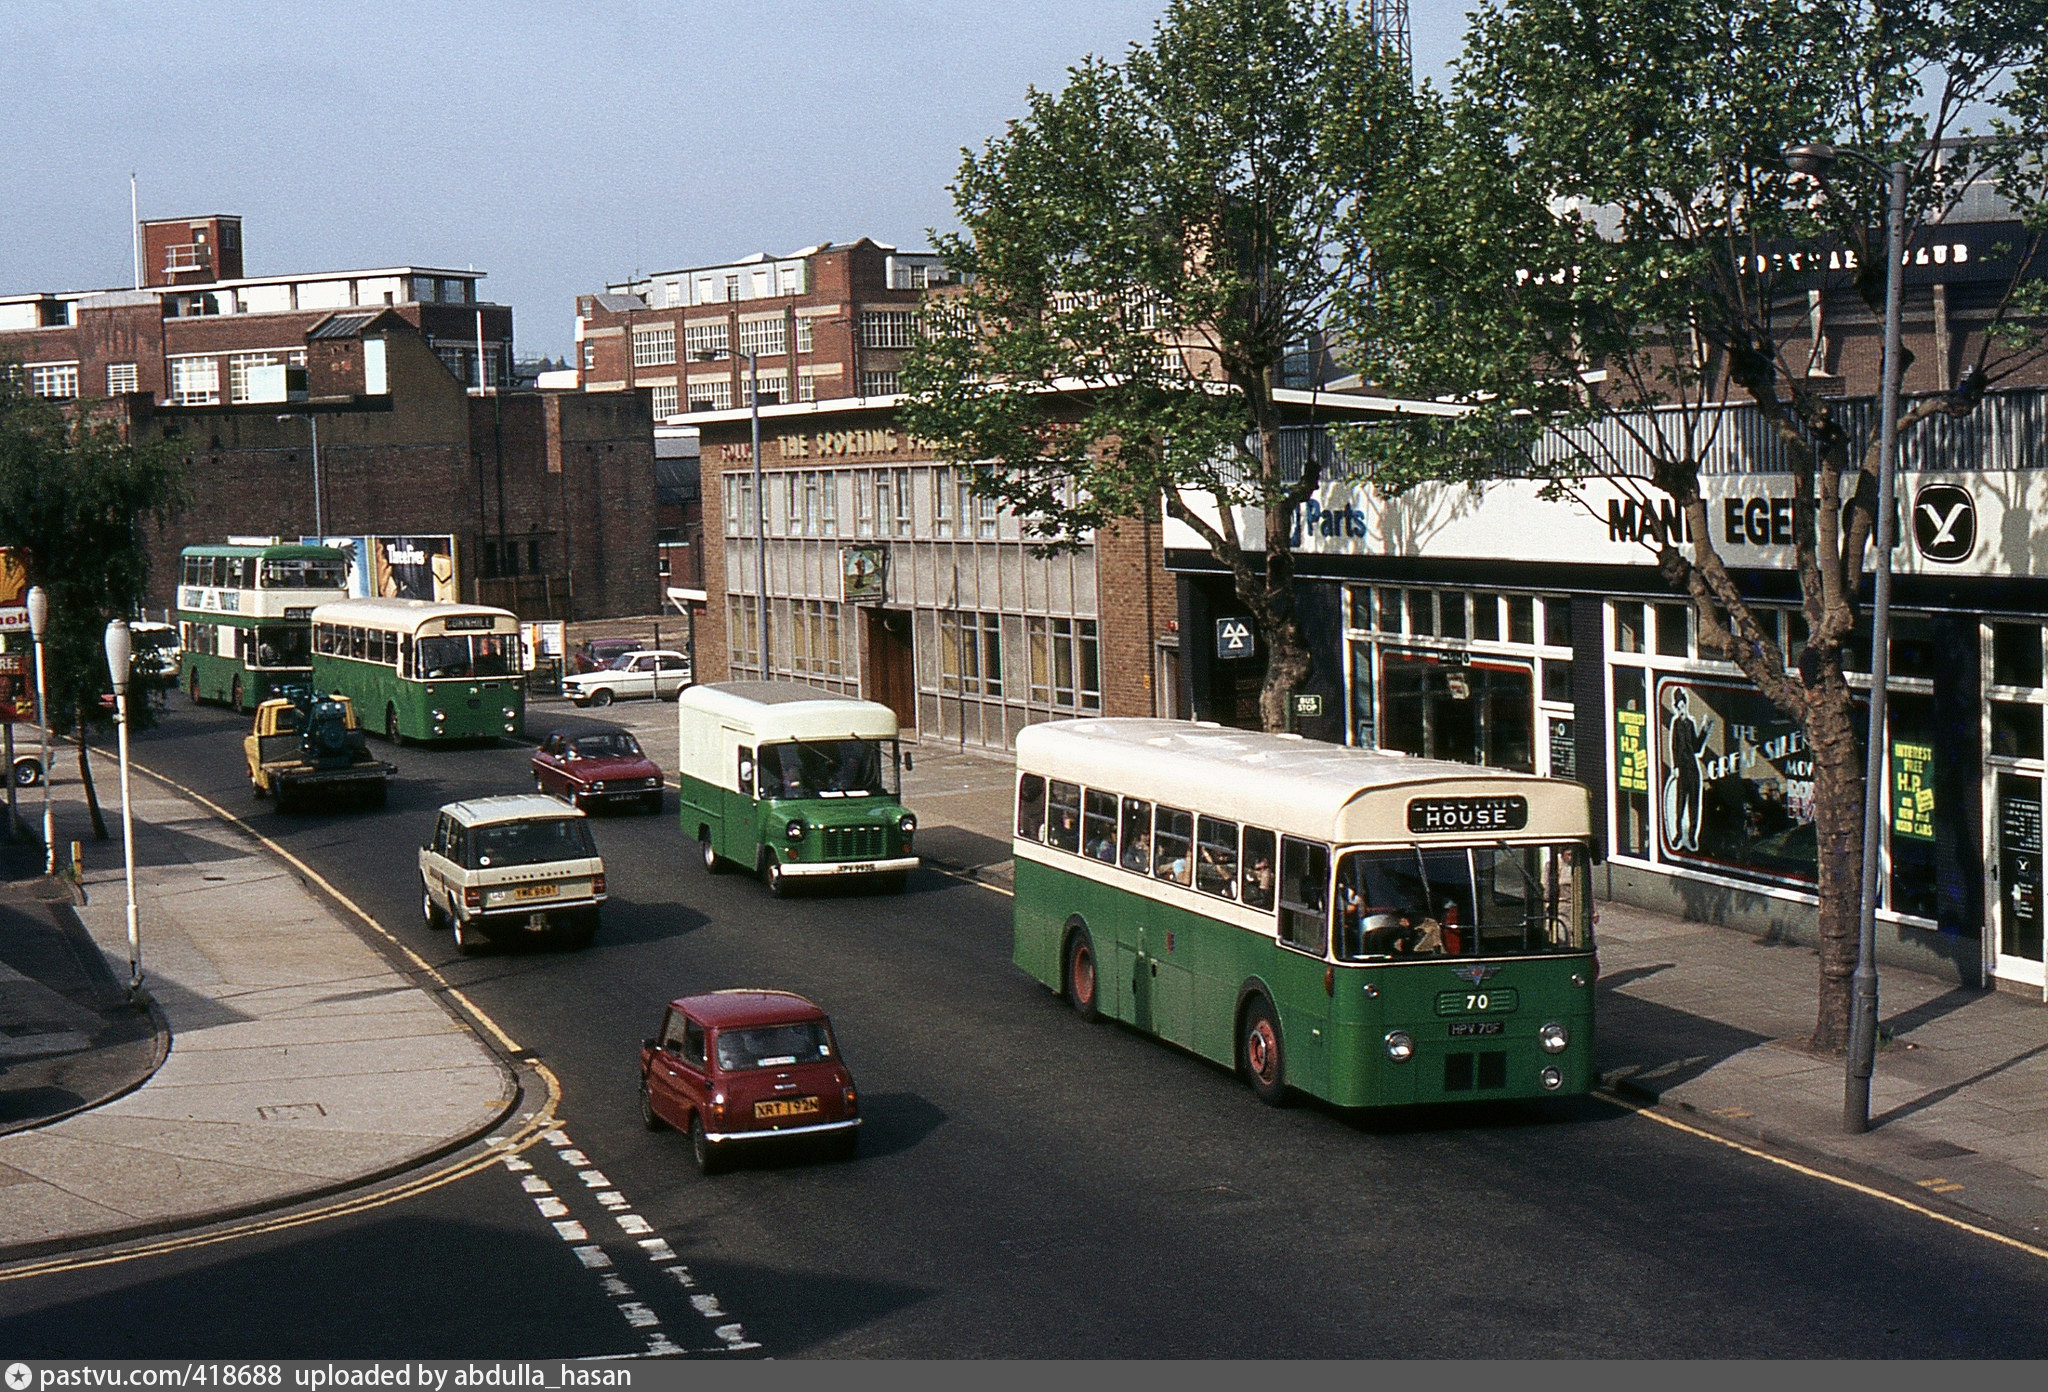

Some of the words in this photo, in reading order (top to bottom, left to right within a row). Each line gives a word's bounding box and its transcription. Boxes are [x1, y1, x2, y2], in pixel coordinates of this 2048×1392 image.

[777, 434, 809, 459] THE
[816, 427, 898, 456] SPORTING
[1306, 499, 1366, 538] Parts
[1731, 724, 1757, 741] THE
[1895, 743, 1932, 761] INTEREST
[1707, 745, 1760, 780] GREAT
[1904, 758, 1923, 773] FREE
[1426, 809, 1507, 826] HOUSE
[1914, 822, 1932, 836] CARS
[1466, 994, 1488, 1009] 70
[1451, 1023, 1474, 1035] HPV
[1478, 1021, 1501, 1033] 70F
[757, 1103, 781, 1117] XRT
[786, 1099, 817, 1115] 192N
